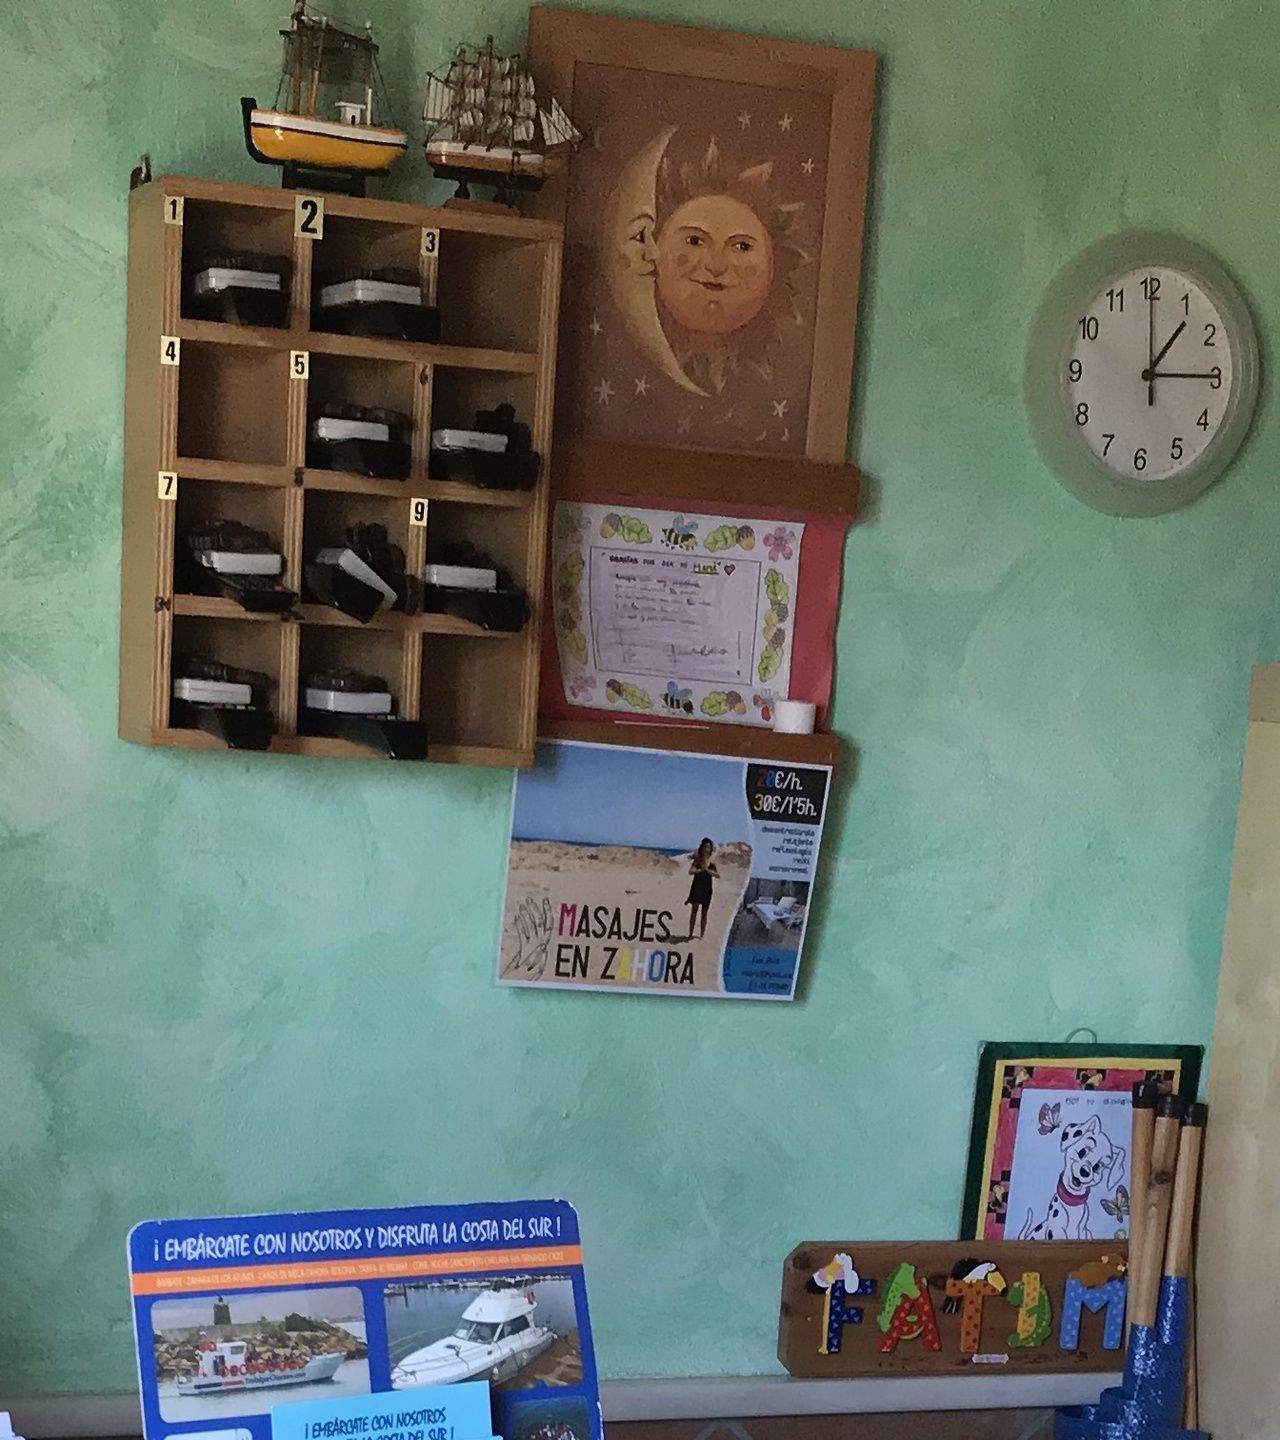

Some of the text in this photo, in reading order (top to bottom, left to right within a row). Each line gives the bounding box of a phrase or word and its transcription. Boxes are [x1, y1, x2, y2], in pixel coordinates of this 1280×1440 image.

[170, 201, 178, 219] 1
[301, 201, 317, 232] 2
[425, 233, 436, 252] 3
[1140, 278, 1160, 300] 12
[1106, 289, 1124, 312] 11
[1181, 293, 1189, 315] 1
[1079, 316, 1099, 341] 10
[1204, 324, 1216, 346] 2
[165, 343, 176, 361] 4
[294, 355, 304, 374] 5
[1069, 359, 1082, 382] 9
[1211, 367, 1222, 389] 3
[1076, 403, 1089, 426] 8
[1196, 409, 1209, 431] 4
[1102, 434, 1114, 456] 7
[1171, 437, 1183, 460] 5
[1134, 448, 1147, 471] 6
[163, 477, 173, 496] 7
[414, 503, 425, 520] 9
[559, 903, 674, 943] MASAJES
[555, 944, 590, 978] EN
[600, 947, 694, 984] ZAHORA
[165, 1217, 553, 1261] EMBÁRCATE CON NOSOTROS Y DISFRUTA LA COSTA DEL SUR
[312, 1407, 447, 1438] EMBÁRCATE CON NOSOTROS
[428, 1428, 447, 1440] SUR
